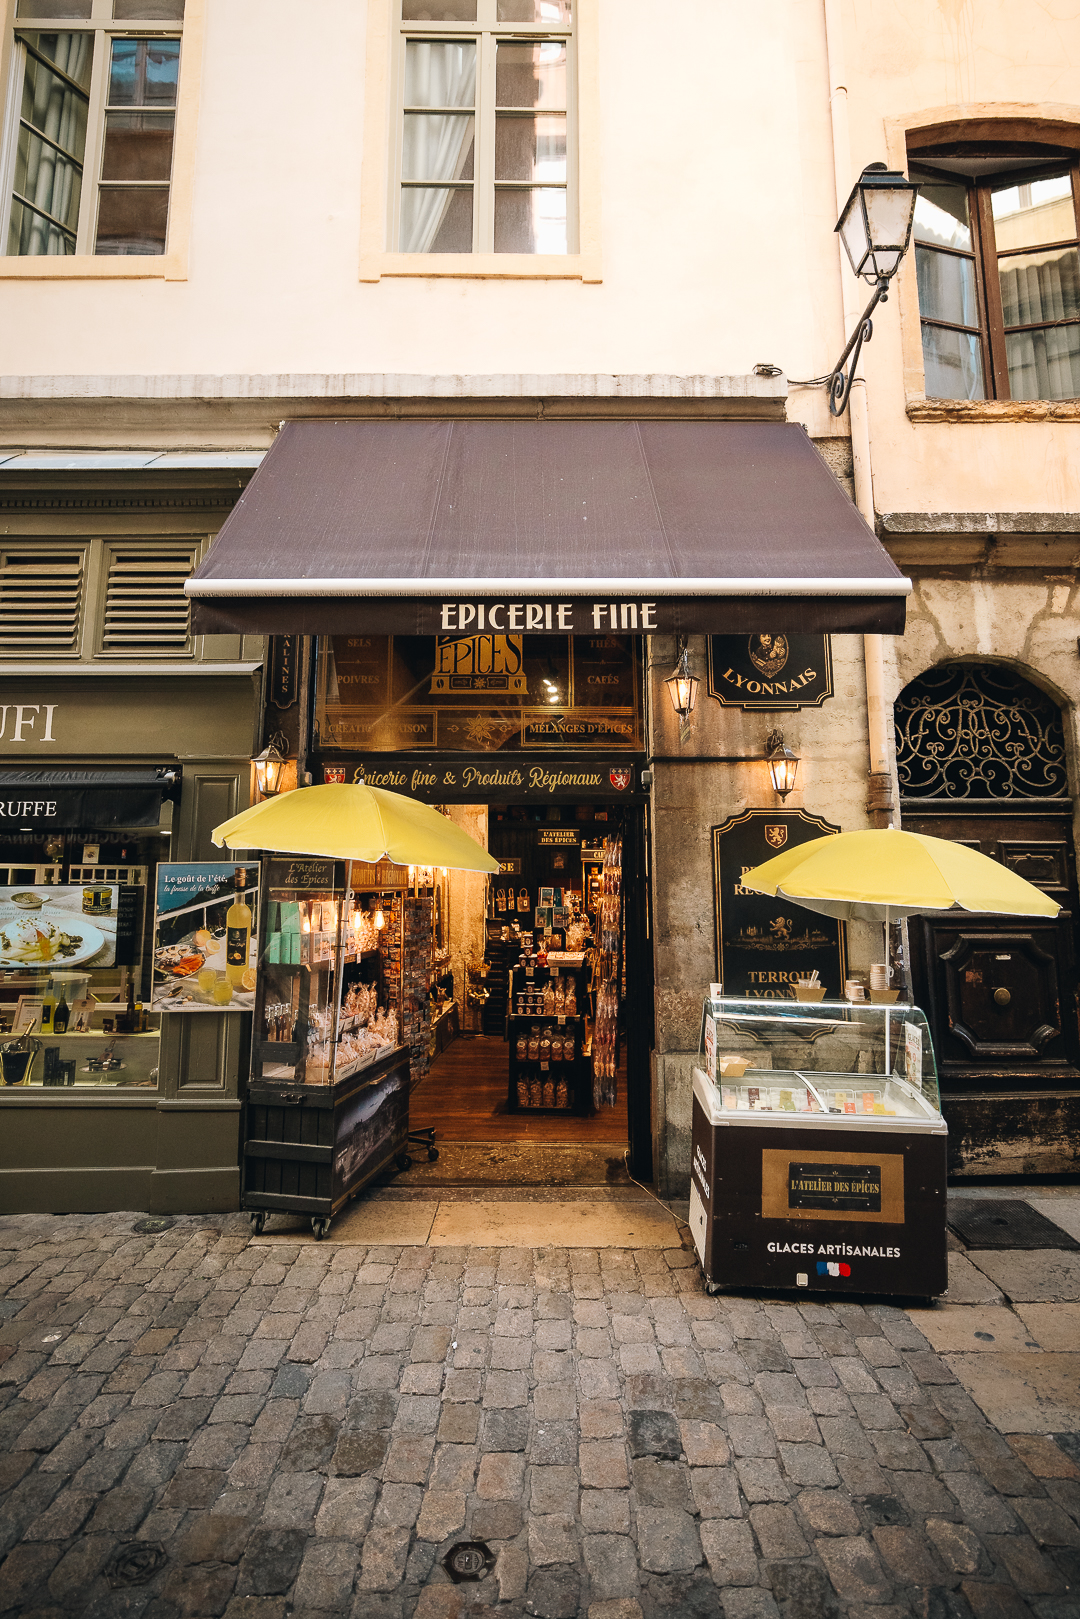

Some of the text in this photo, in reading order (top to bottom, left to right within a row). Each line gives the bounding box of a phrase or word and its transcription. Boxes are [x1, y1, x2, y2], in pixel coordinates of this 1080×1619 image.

[439, 602, 658, 630] EPICERIE FINE
[347, 638, 371, 648] SELS
[589, 637, 616, 648] THÉS
[437, 635, 522, 675] ÉPICES
[281, 634, 291, 693] ALINES
[337, 675, 379, 684] POIVRES
[587, 673, 619, 685] CAFÉS
[721, 666, 817, 696] LYONNAIS
[529, 721, 633, 734] MÉLANGES D'ÉPICES
[411, 769, 438, 791] fine
[443, 771, 457, 785] &
[462, 766, 524, 788] Produits
[529, 766, 602, 793] Régionaux
[288, 862, 327, 873] L'Atelier
[164, 874, 228, 885] Le goût de l'été,
[285, 872, 329, 887] des Épices
[834, 1181, 850, 1193] DES
[766, 1241, 815, 1255] GLACES
